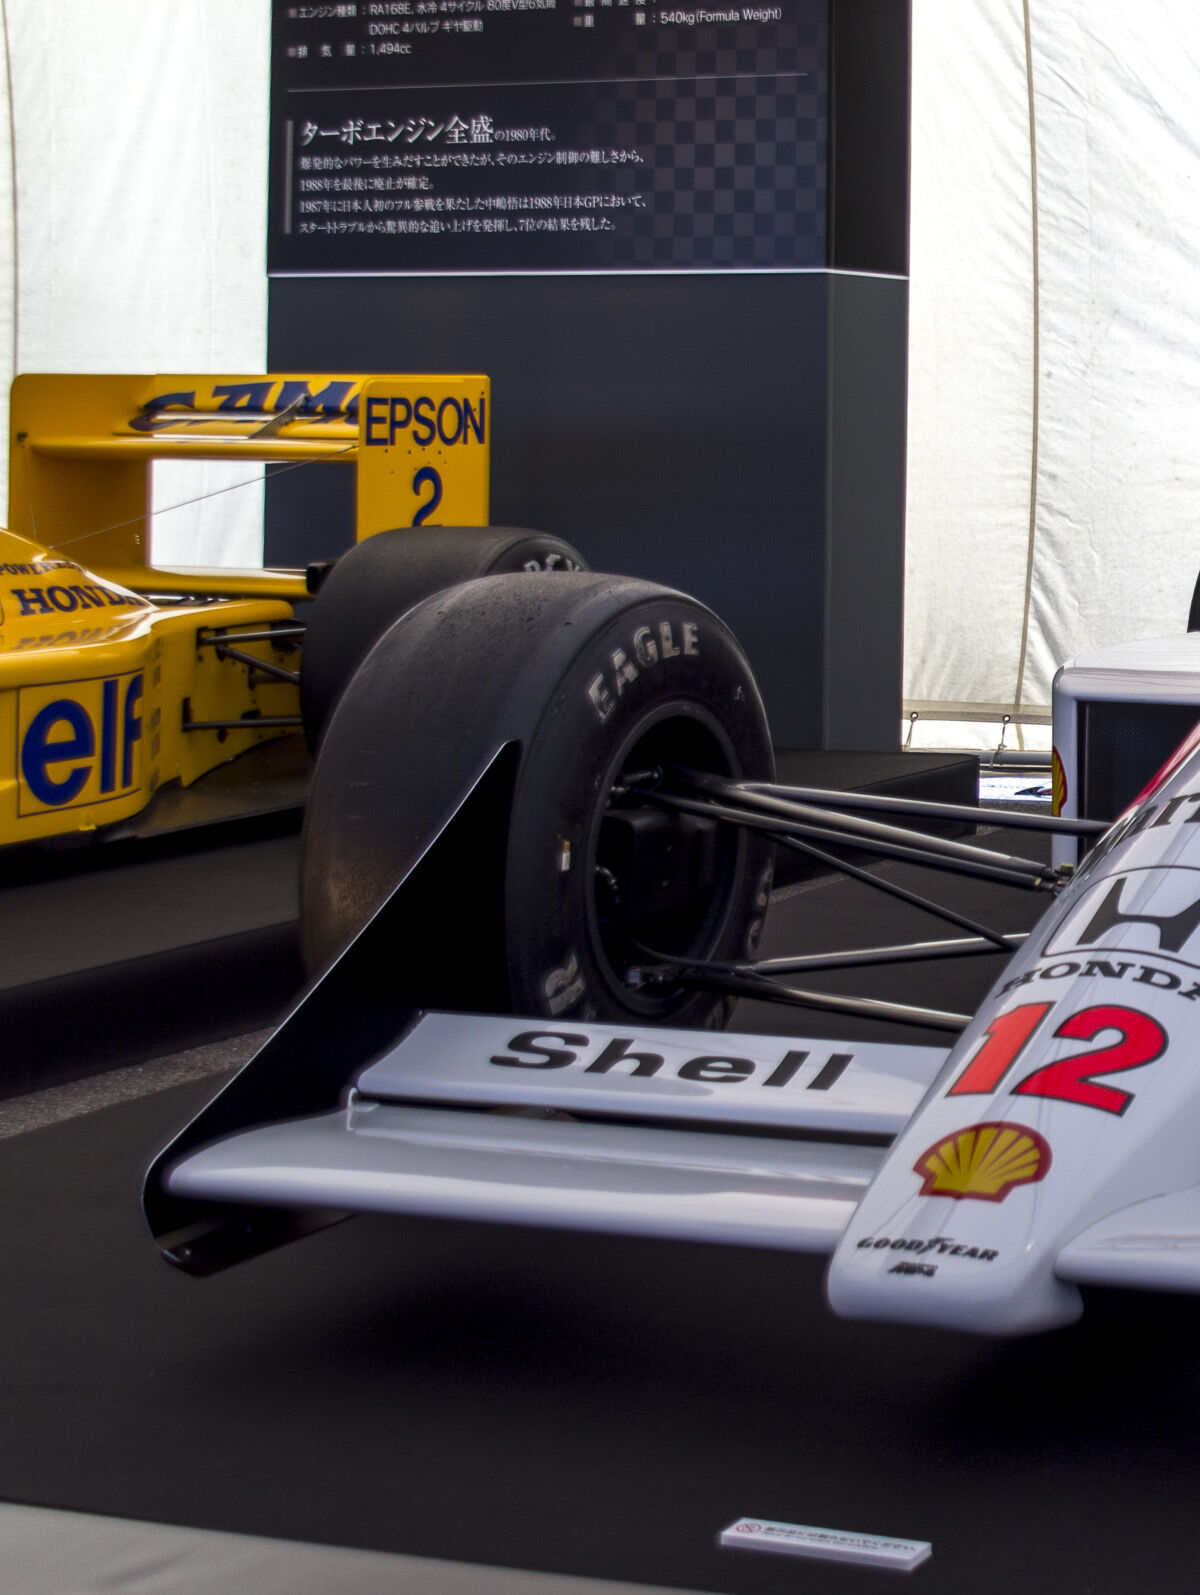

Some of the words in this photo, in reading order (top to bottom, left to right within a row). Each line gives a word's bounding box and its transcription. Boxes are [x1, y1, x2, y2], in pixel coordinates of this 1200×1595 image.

[369, 24, 400, 36] DOHC
[743, 7, 782, 21] Weight)
[301, 114, 556, 147] ターボエンジン全盛の1980年代。
[365, 396, 486, 446] EPSON
[412, 466, 443, 527] 2
[588, 621, 700, 723] EAGLE
[22, 673, 144, 806] elf
[489, 1030, 854, 1090] Shell
[944, 1000, 1169, 1117] 12
